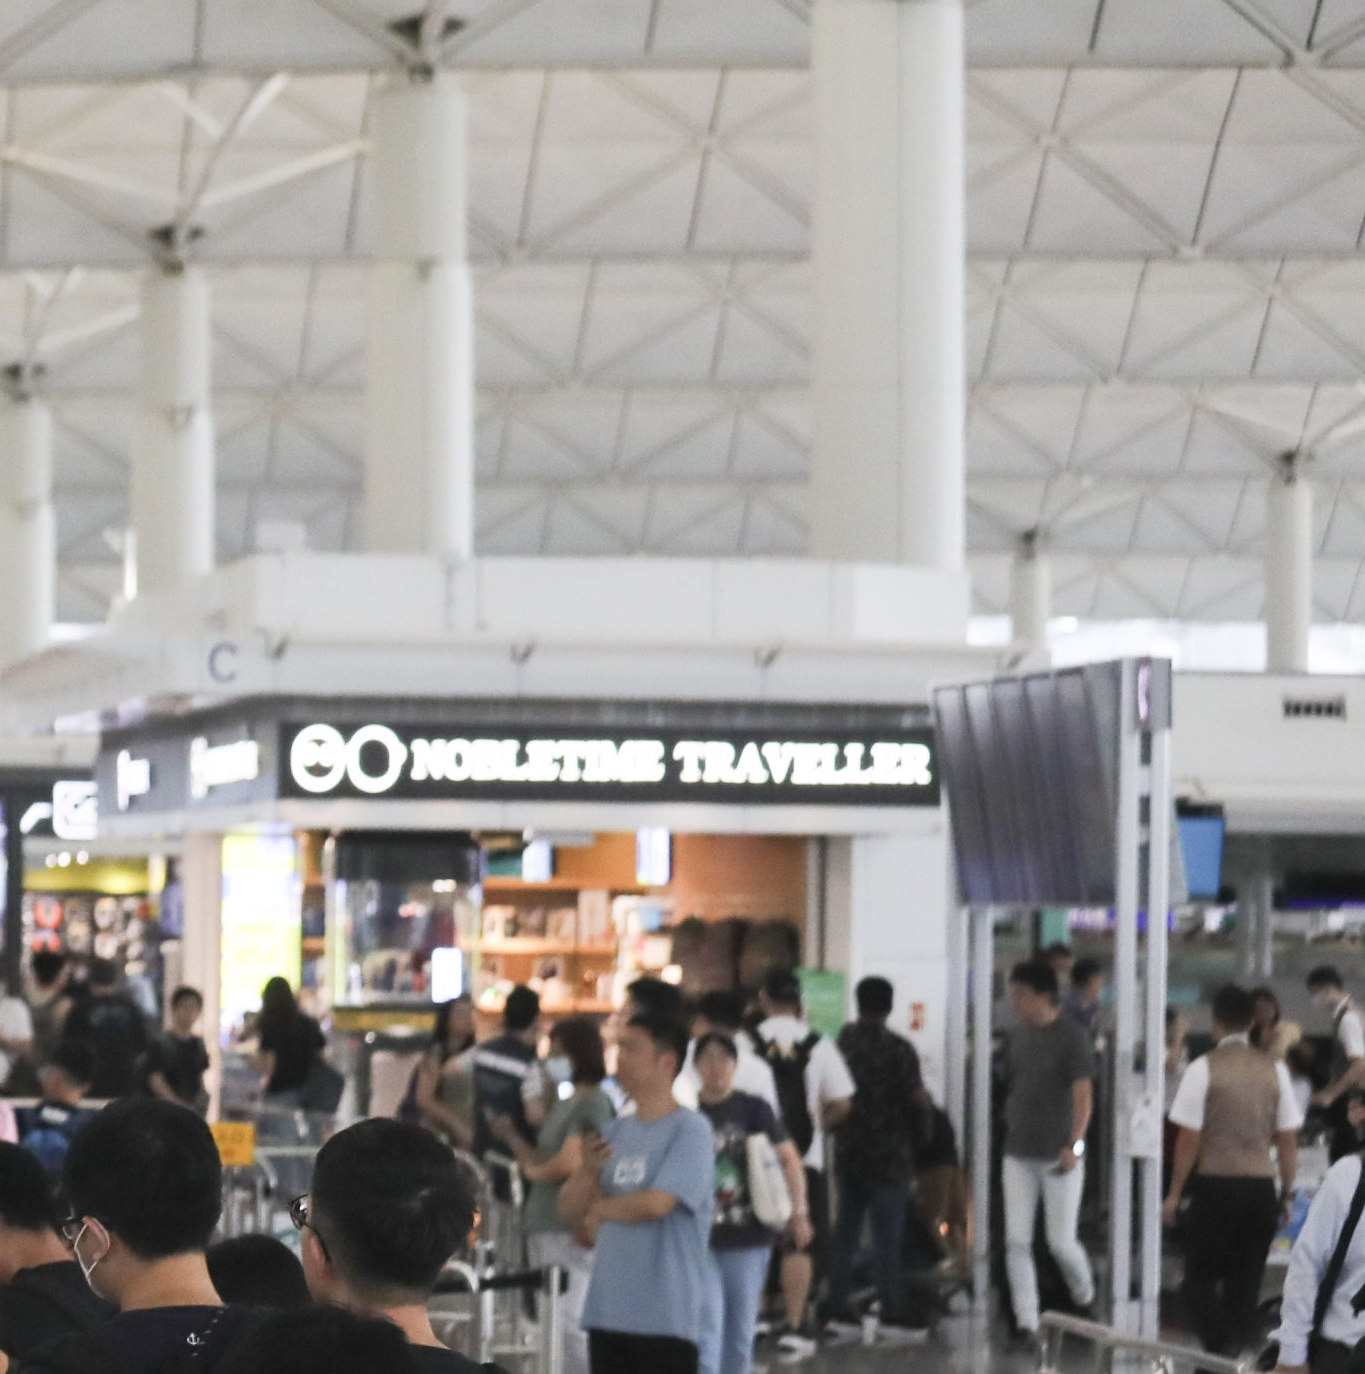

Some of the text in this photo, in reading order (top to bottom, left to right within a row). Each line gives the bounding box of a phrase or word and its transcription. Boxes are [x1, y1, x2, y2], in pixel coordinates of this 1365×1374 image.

[208, 641, 238, 683] C
[410, 738, 932, 785] NOBLETIME TRAVELLER
